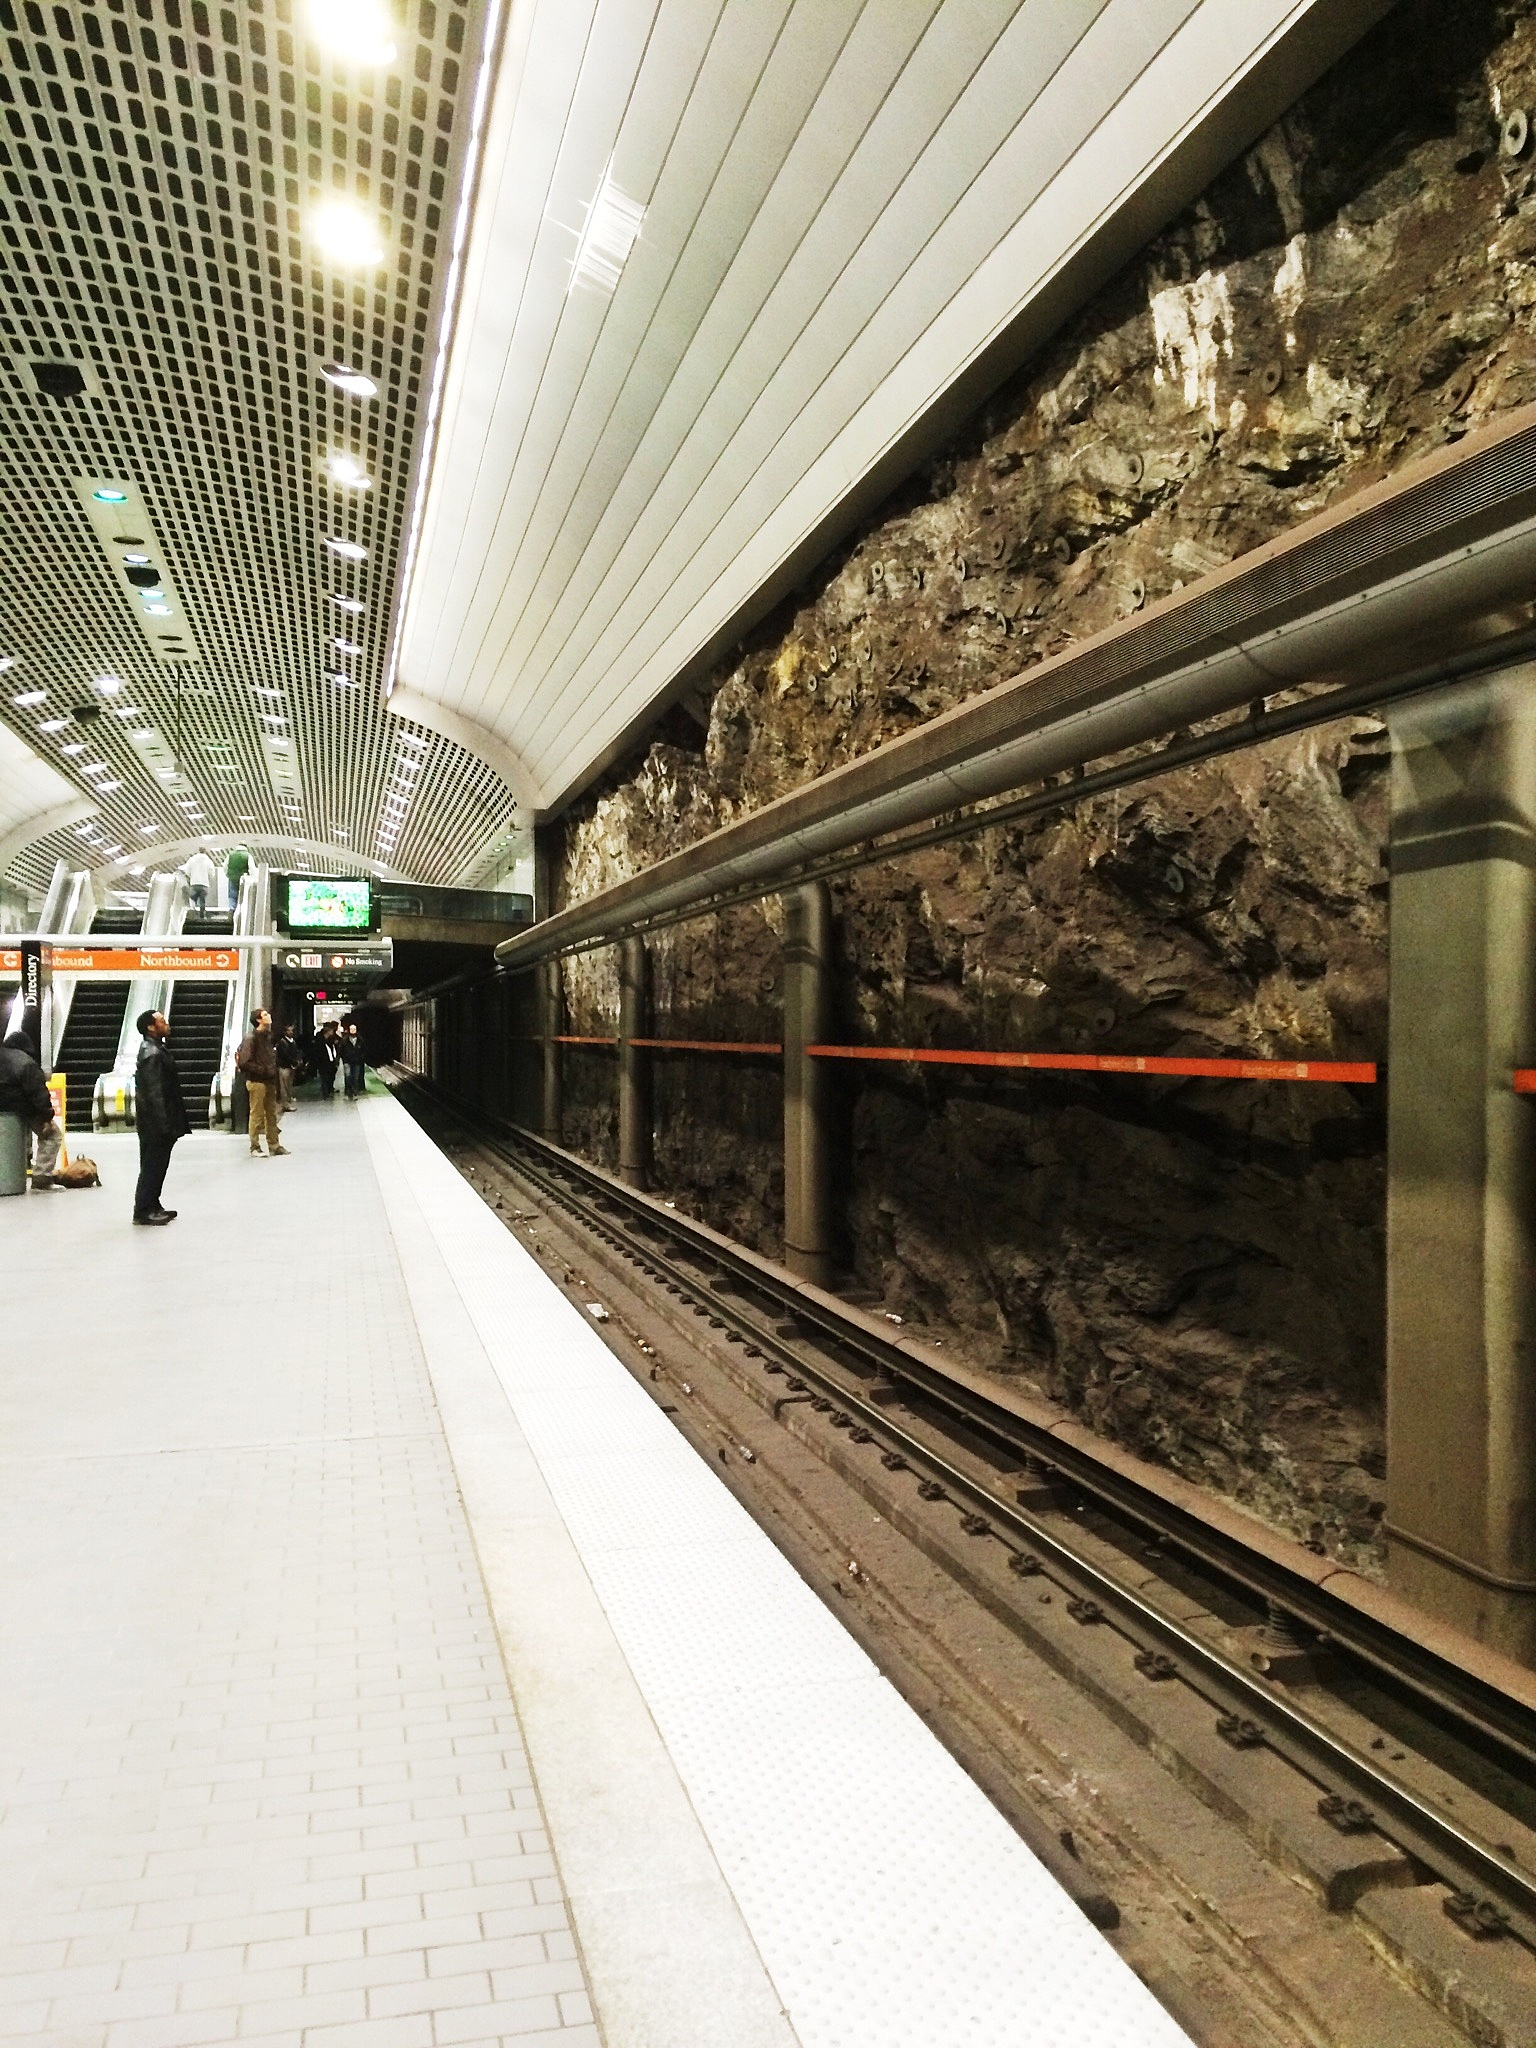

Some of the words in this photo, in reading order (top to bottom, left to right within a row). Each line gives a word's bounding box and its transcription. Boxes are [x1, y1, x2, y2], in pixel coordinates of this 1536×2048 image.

[140, 955, 212, 967] Northbound
[305, 956, 319, 967] EXIT
[345, 957, 355, 966] No
[356, 958, 383, 967] Smoking
[24, 953, 40, 1007] Directory
